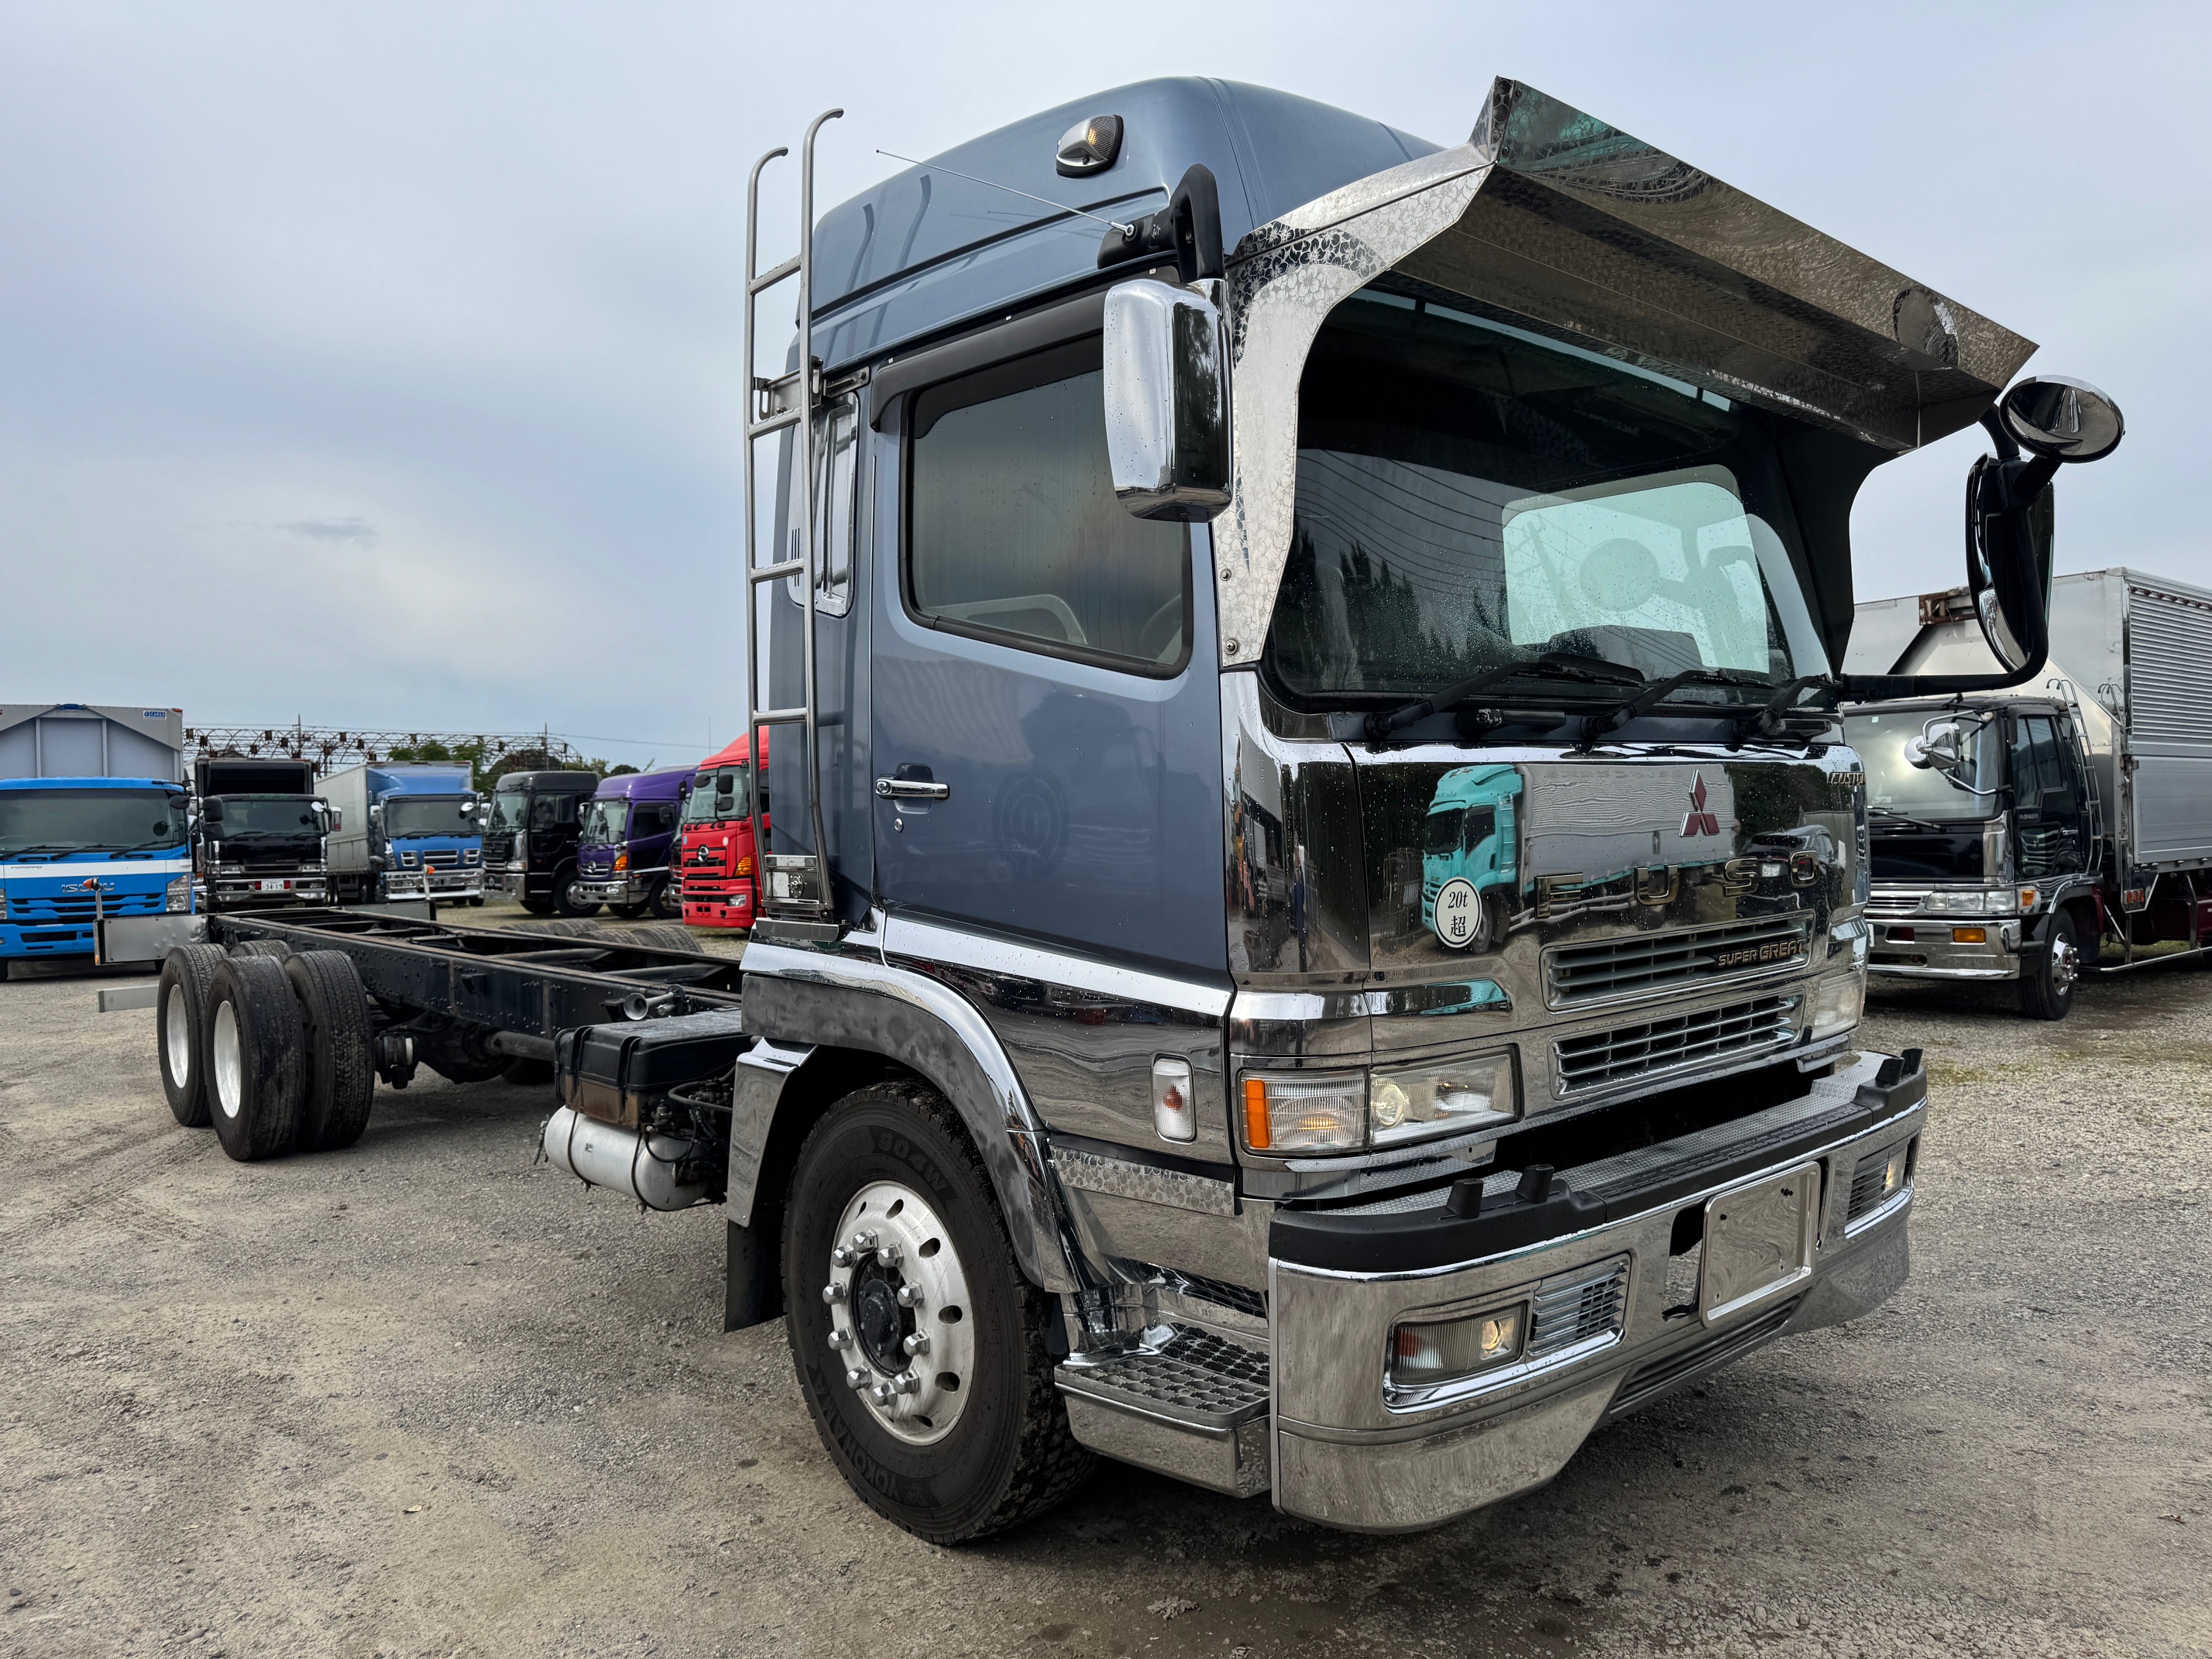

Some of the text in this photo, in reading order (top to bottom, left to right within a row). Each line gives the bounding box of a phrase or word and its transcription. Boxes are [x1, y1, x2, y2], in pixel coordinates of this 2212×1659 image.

[61, 882, 115, 893] ISUU
[1534, 849, 1821, 920] FUSO
[1448, 891, 1468, 909] 20t
[1450, 915, 1467, 937] 超
[1717, 937, 1807, 967] SUPER GREAT
[878, 1131, 950, 1193] 904W
[811, 1374, 902, 1503] YOKOHAMA
